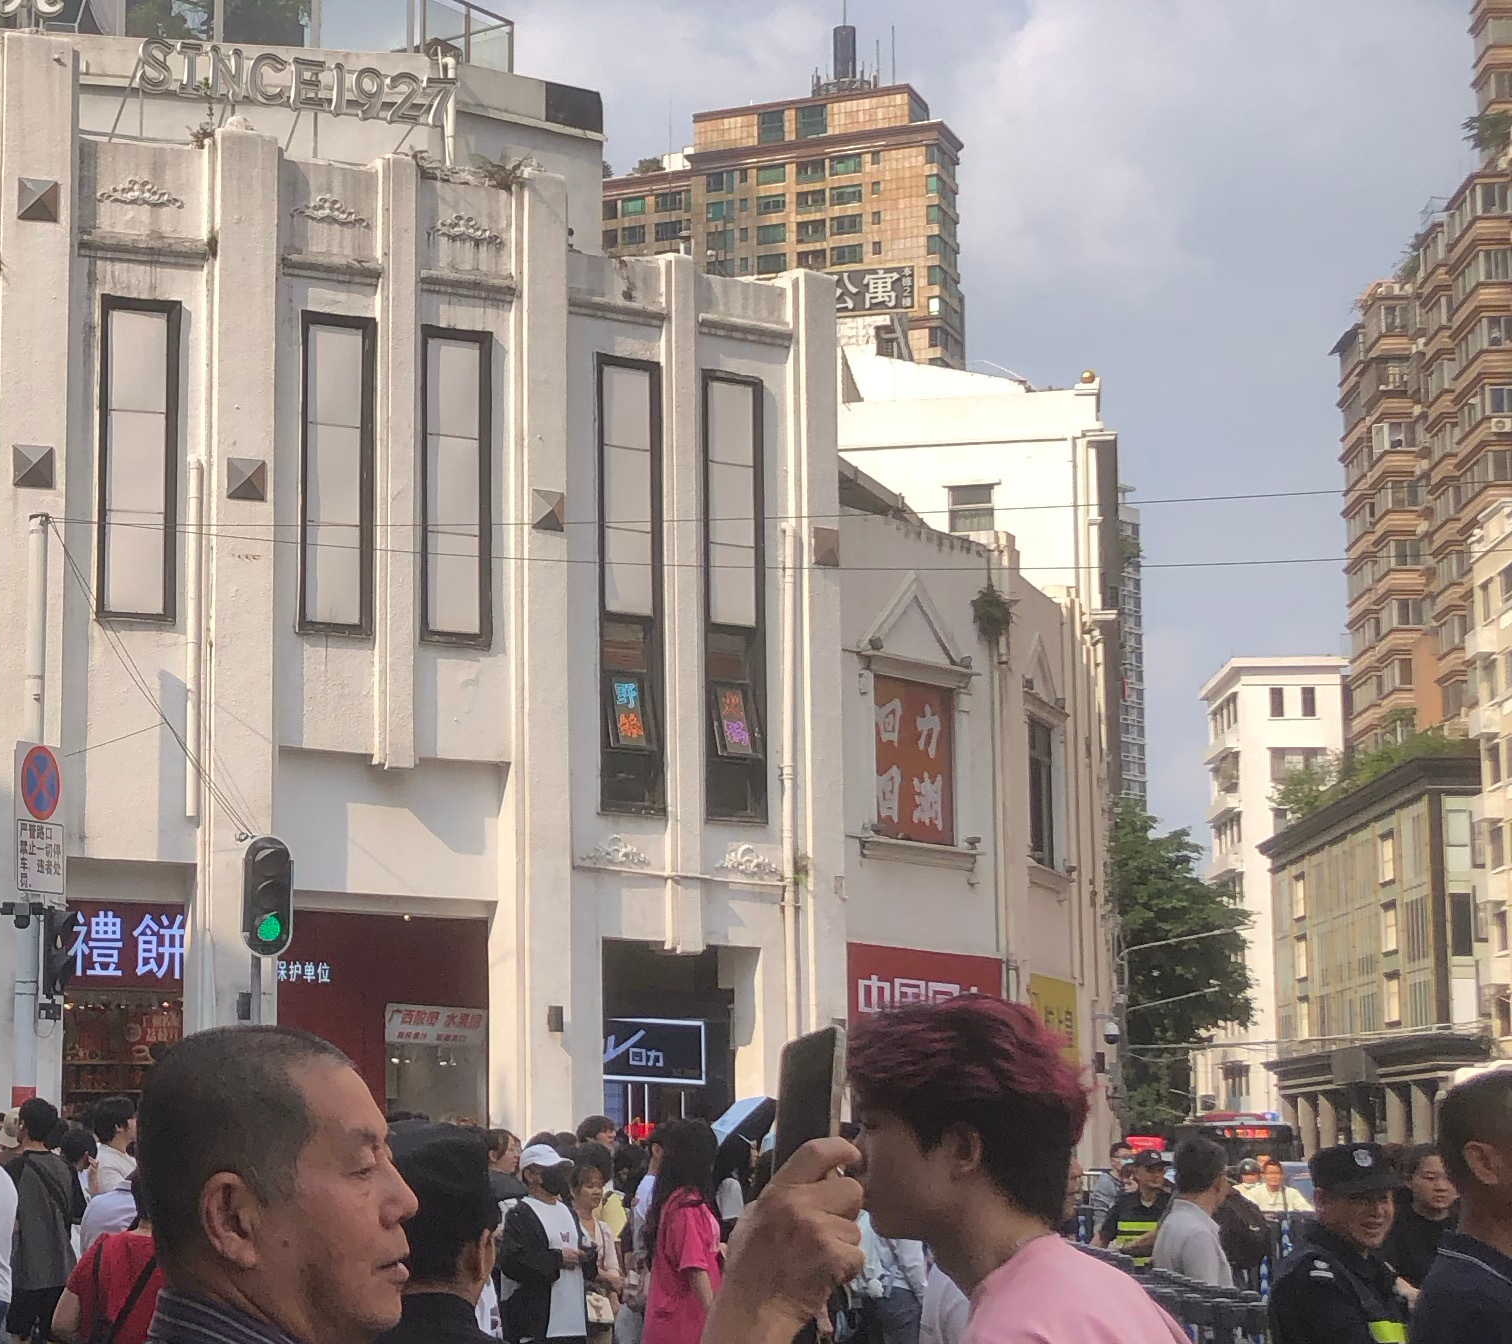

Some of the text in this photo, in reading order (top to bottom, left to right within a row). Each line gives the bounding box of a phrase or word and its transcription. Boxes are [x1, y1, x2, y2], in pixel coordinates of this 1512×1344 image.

[136, 38, 458, 128] SINCE1927
[836, 269, 900, 310] 公寓
[875, 698, 941, 759] 回力
[19, 840, 62, 859] 禁止一切停
[67, 910, 184, 981] 禮餅
[858, 974, 979, 1014] 中国回
[629, 1047, 664, 1067] 回力
